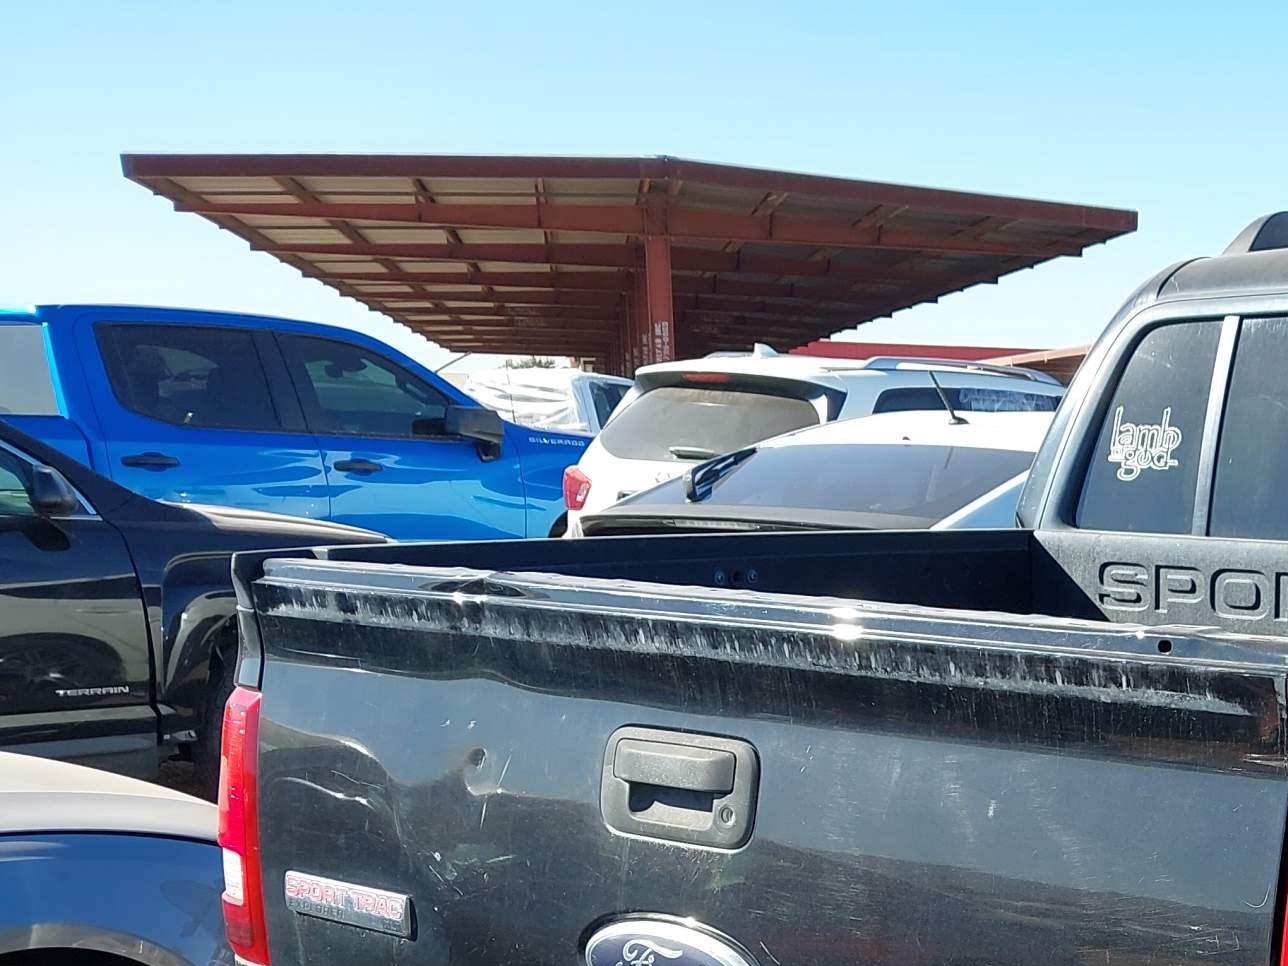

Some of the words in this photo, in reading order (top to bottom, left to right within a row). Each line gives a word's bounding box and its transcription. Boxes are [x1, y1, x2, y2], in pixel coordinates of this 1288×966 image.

[528, 436, 585, 447] SILVERADO
[1111, 406, 1182, 452] lamb
[1117, 448, 1178, 481] god
[56, 685, 129, 696] TERRAIN
[286, 875, 347, 909] SPORT
[349, 889, 404, 921] TRAC
